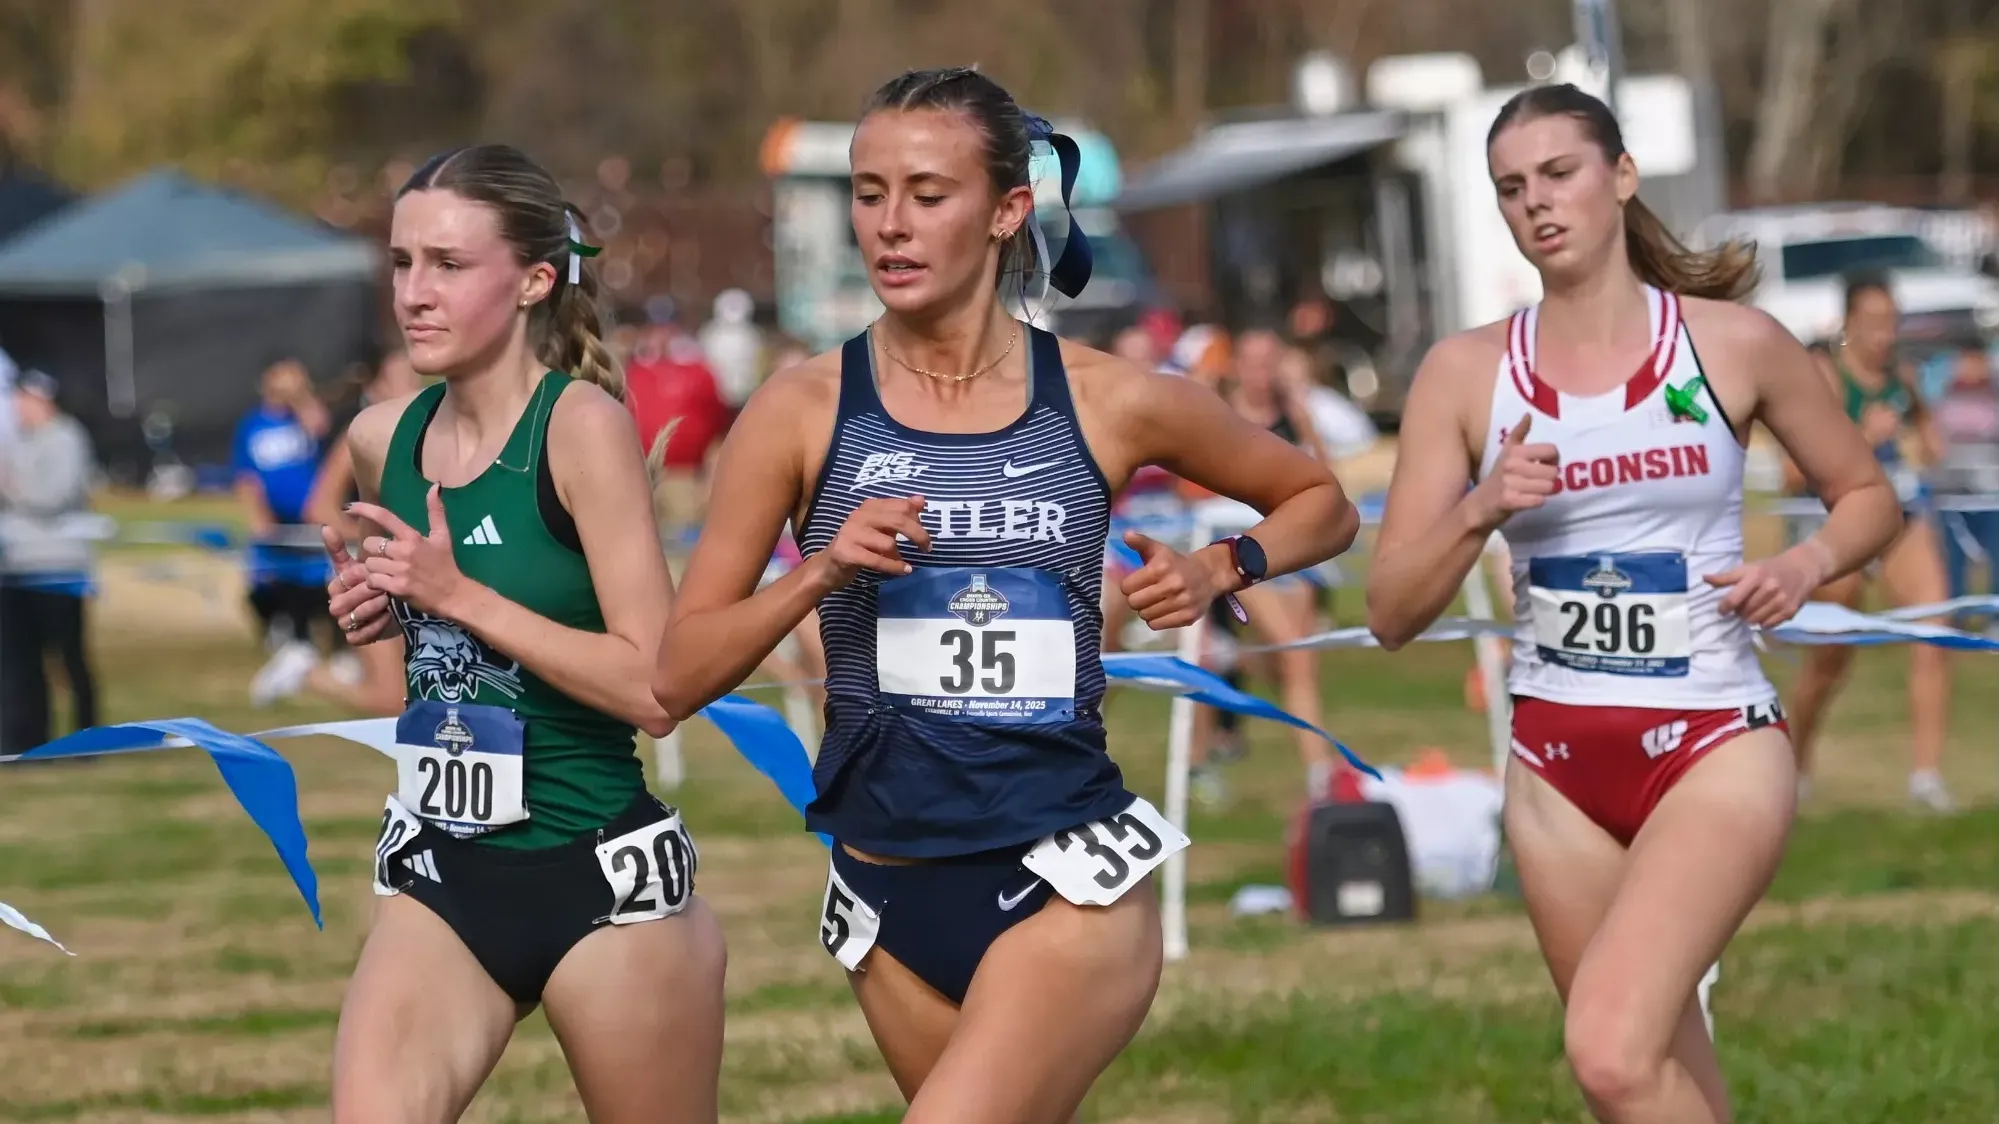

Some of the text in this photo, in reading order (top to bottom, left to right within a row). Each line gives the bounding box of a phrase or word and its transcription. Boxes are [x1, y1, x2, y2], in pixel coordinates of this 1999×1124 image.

[854, 465, 930, 483] EAST
[864, 452, 916, 466] BIG
[895, 500, 1067, 544] TLER
[950, 602, 1008, 611] CHAMPIONSHIPS
[1560, 601, 1656, 655] 296
[939, 629, 1016, 695] 35
[911, 697, 1046, 711] GREAT LAKES November 14, 2025
[418, 757, 493, 821] 200
[1053, 812, 1163, 890] 35
[821, 880, 855, 958] 5
